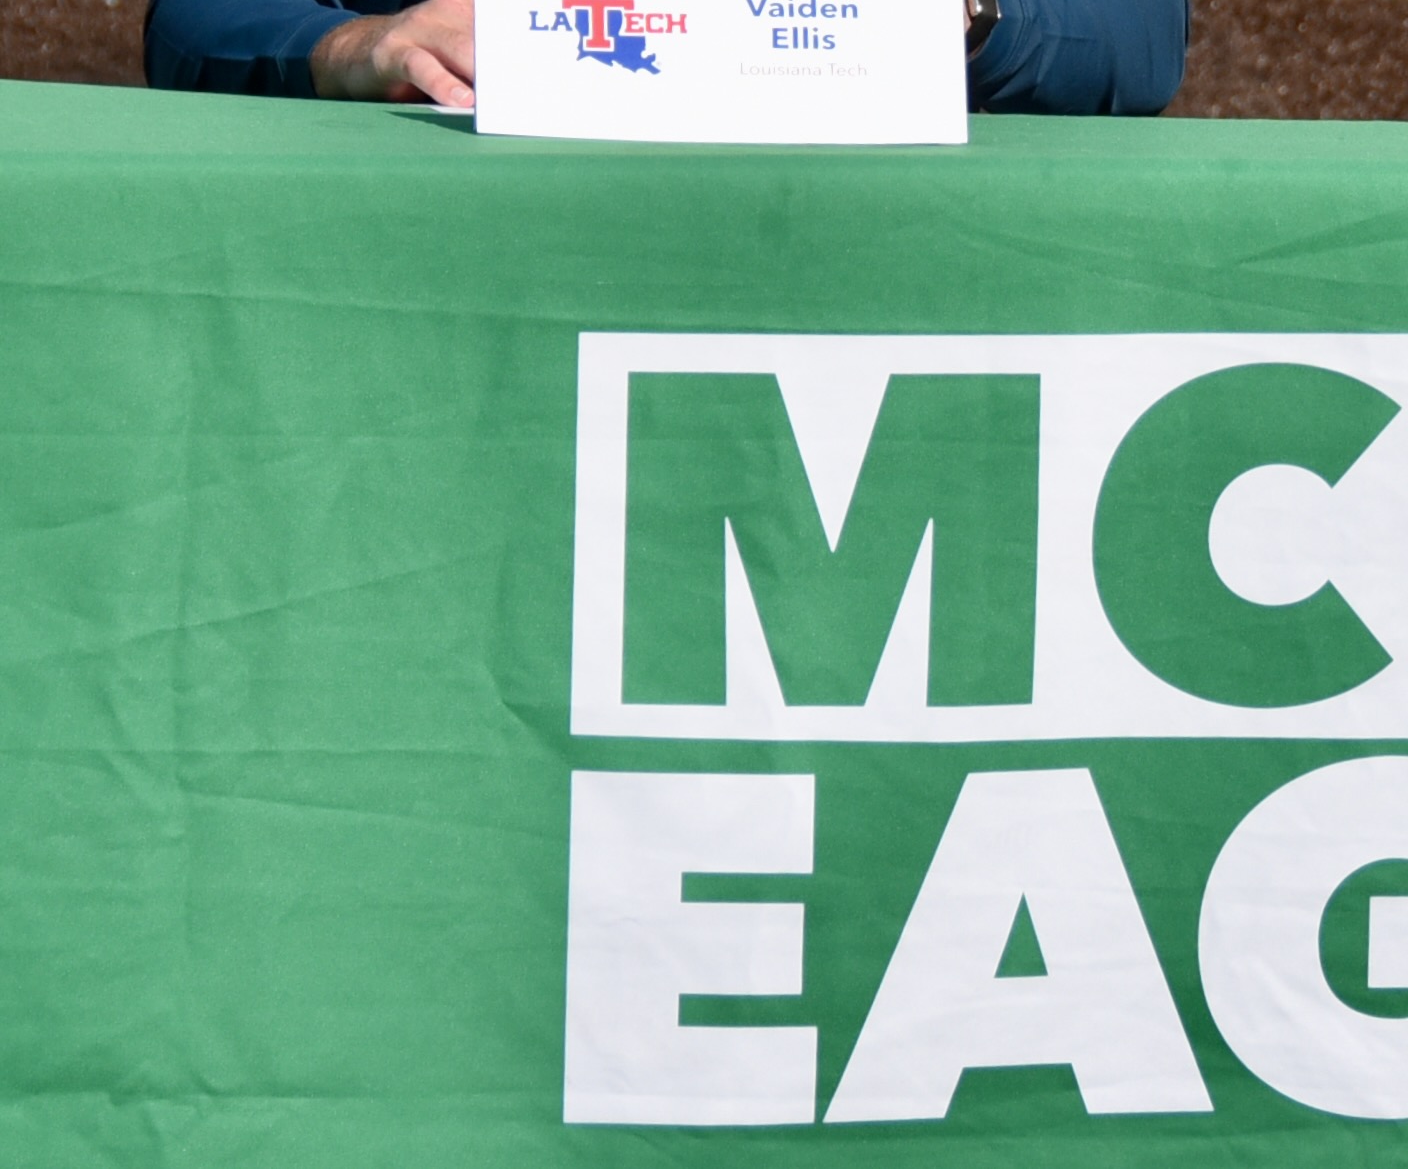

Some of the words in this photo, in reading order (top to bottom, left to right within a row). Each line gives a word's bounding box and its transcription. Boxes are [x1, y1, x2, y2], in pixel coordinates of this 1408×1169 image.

[771, 26, 836, 50] Ellis
[739, 62, 822, 76] Louisiana
[828, 62, 868, 77] Tech
